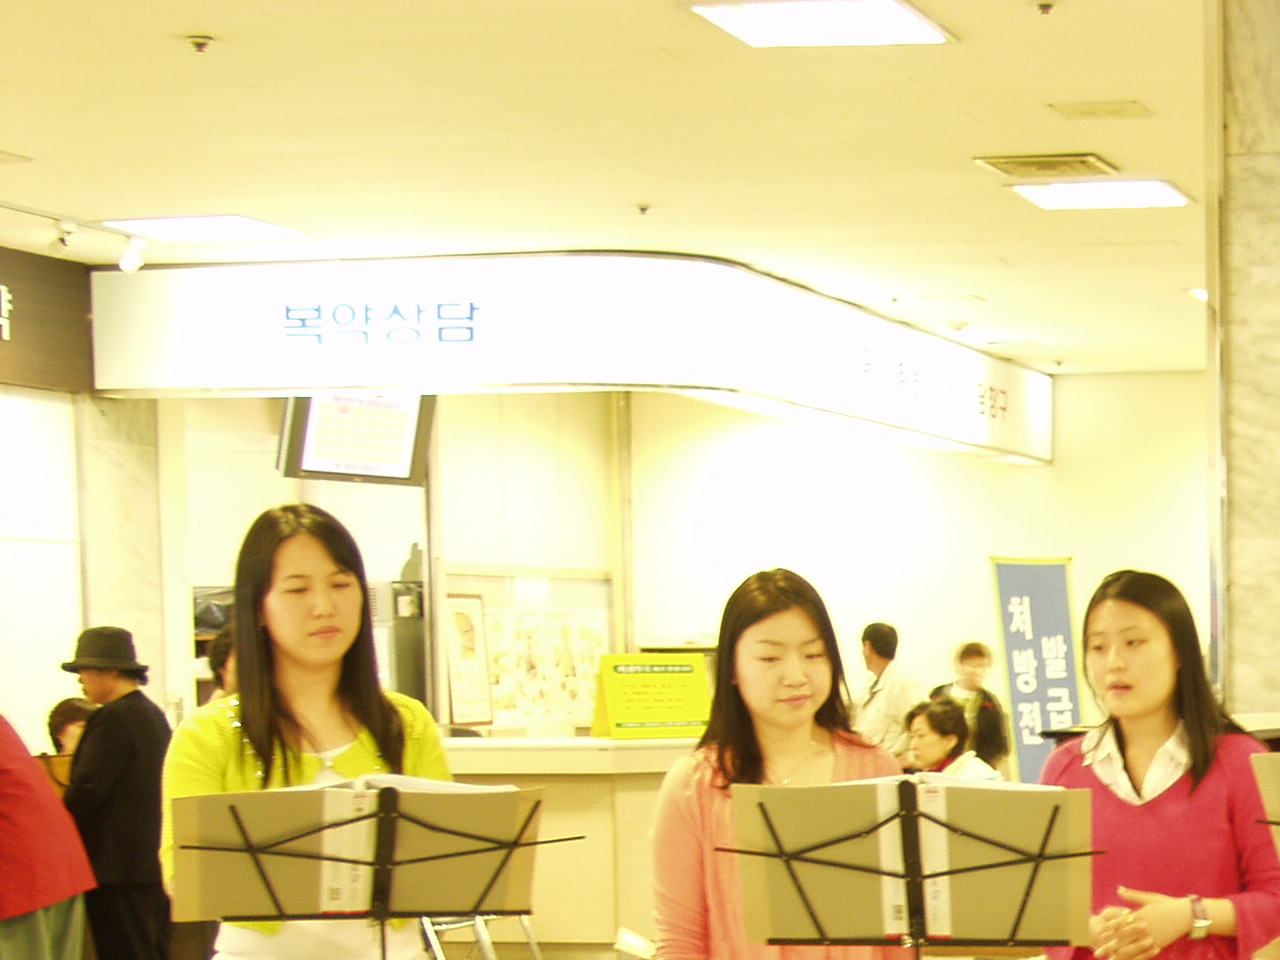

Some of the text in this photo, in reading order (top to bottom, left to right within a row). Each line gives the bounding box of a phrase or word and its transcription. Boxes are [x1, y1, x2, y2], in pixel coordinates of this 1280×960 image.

[284, 302, 480, 344] 복약상담
[1007, 595, 1045, 746] 처방전
[1041, 634, 1074, 732] 발급
